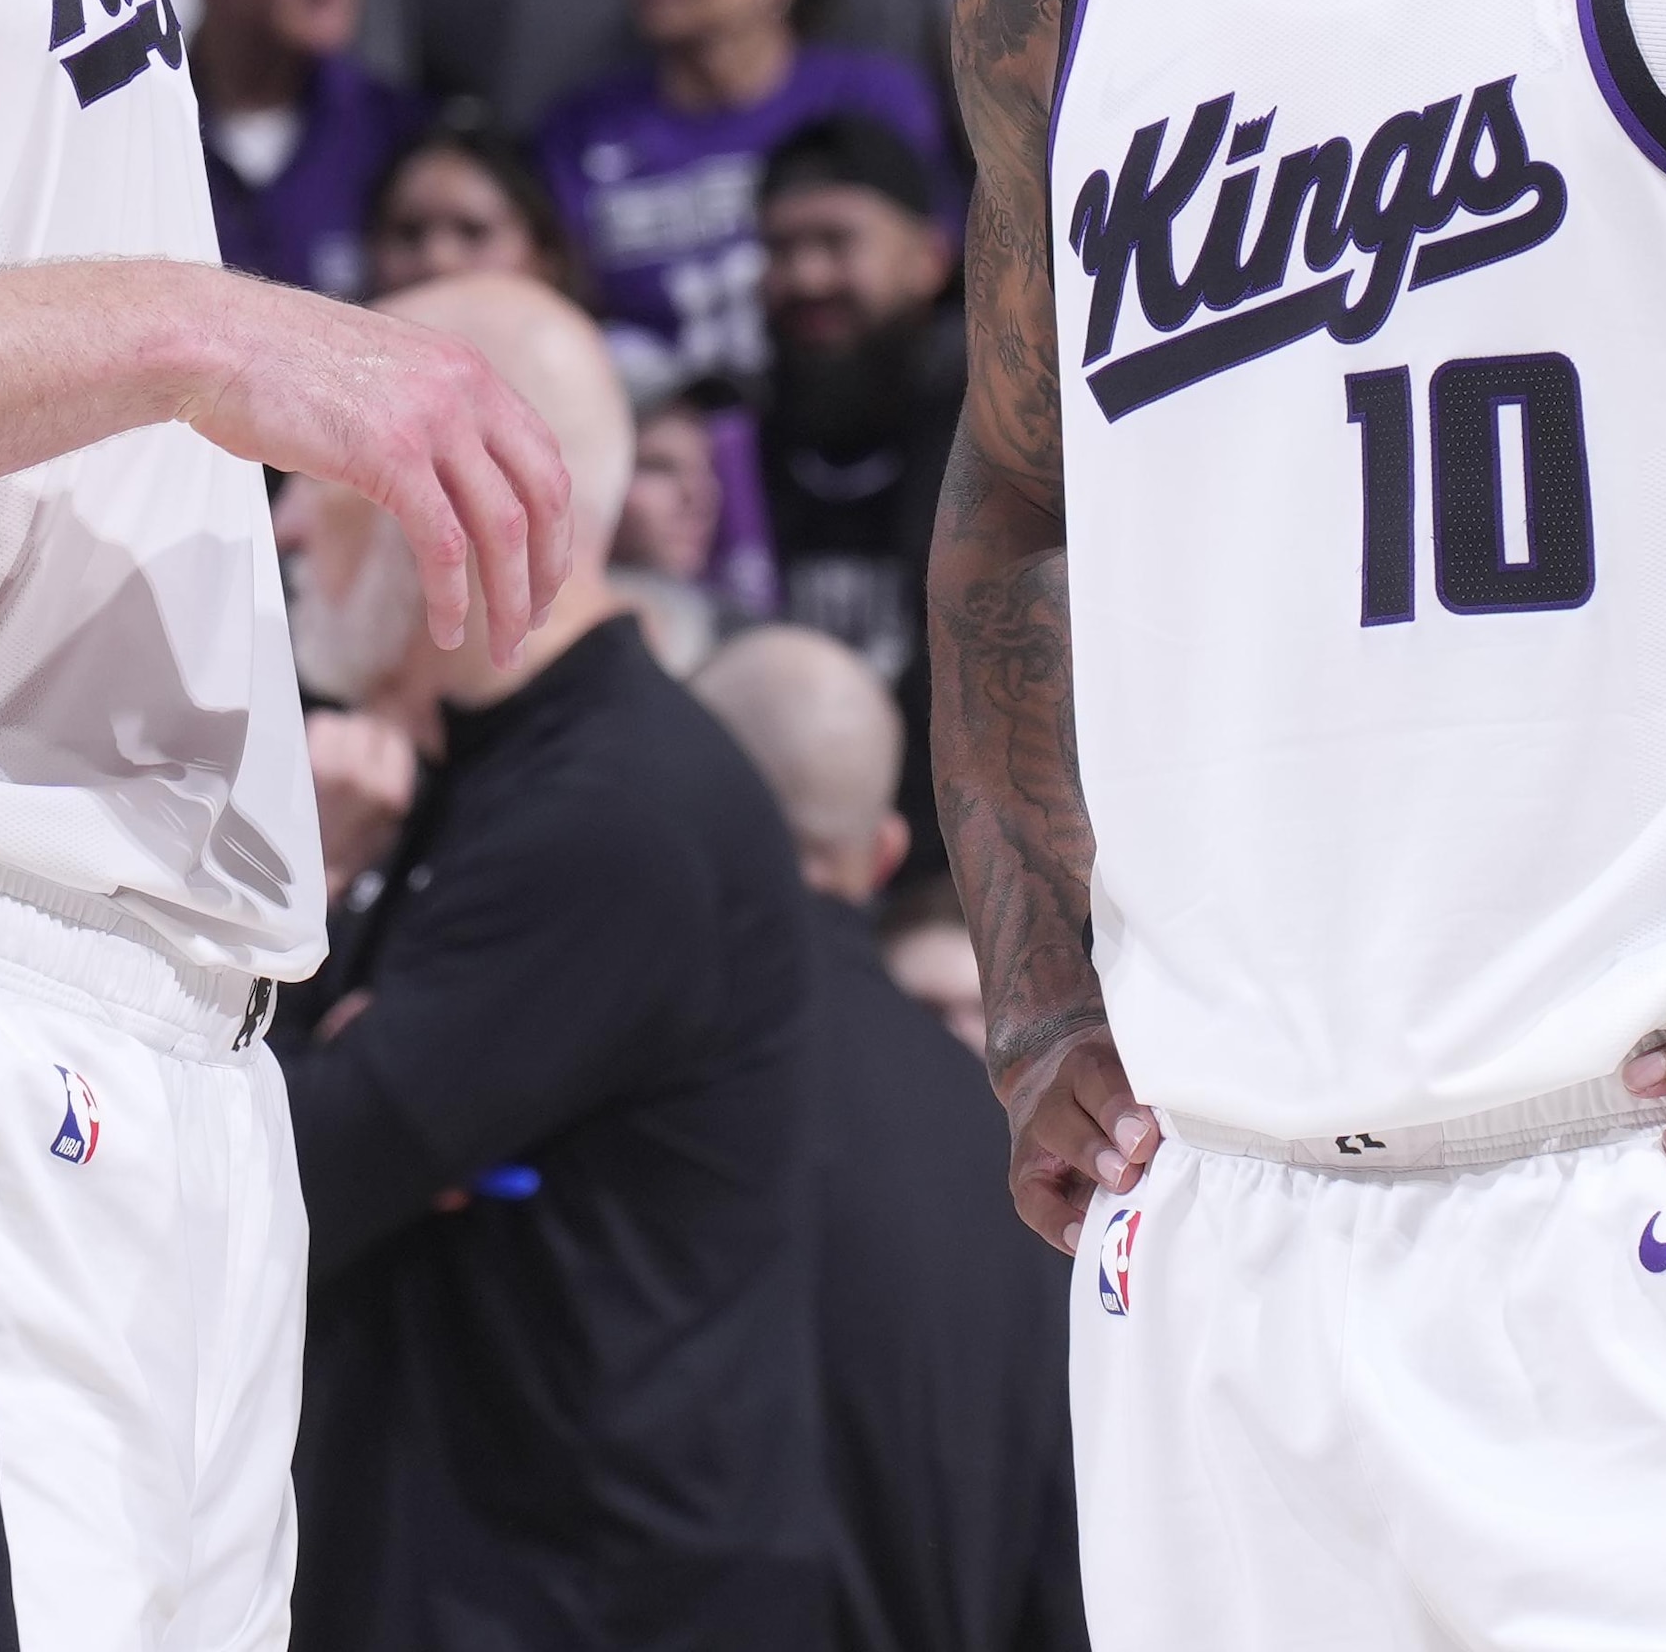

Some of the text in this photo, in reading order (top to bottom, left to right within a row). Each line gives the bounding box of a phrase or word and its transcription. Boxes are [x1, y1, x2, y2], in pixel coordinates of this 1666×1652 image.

[1070, 75, 1567, 423] Kings
[1345, 351, 1596, 627] 10
[55, 1135, 82, 1159] NBA
